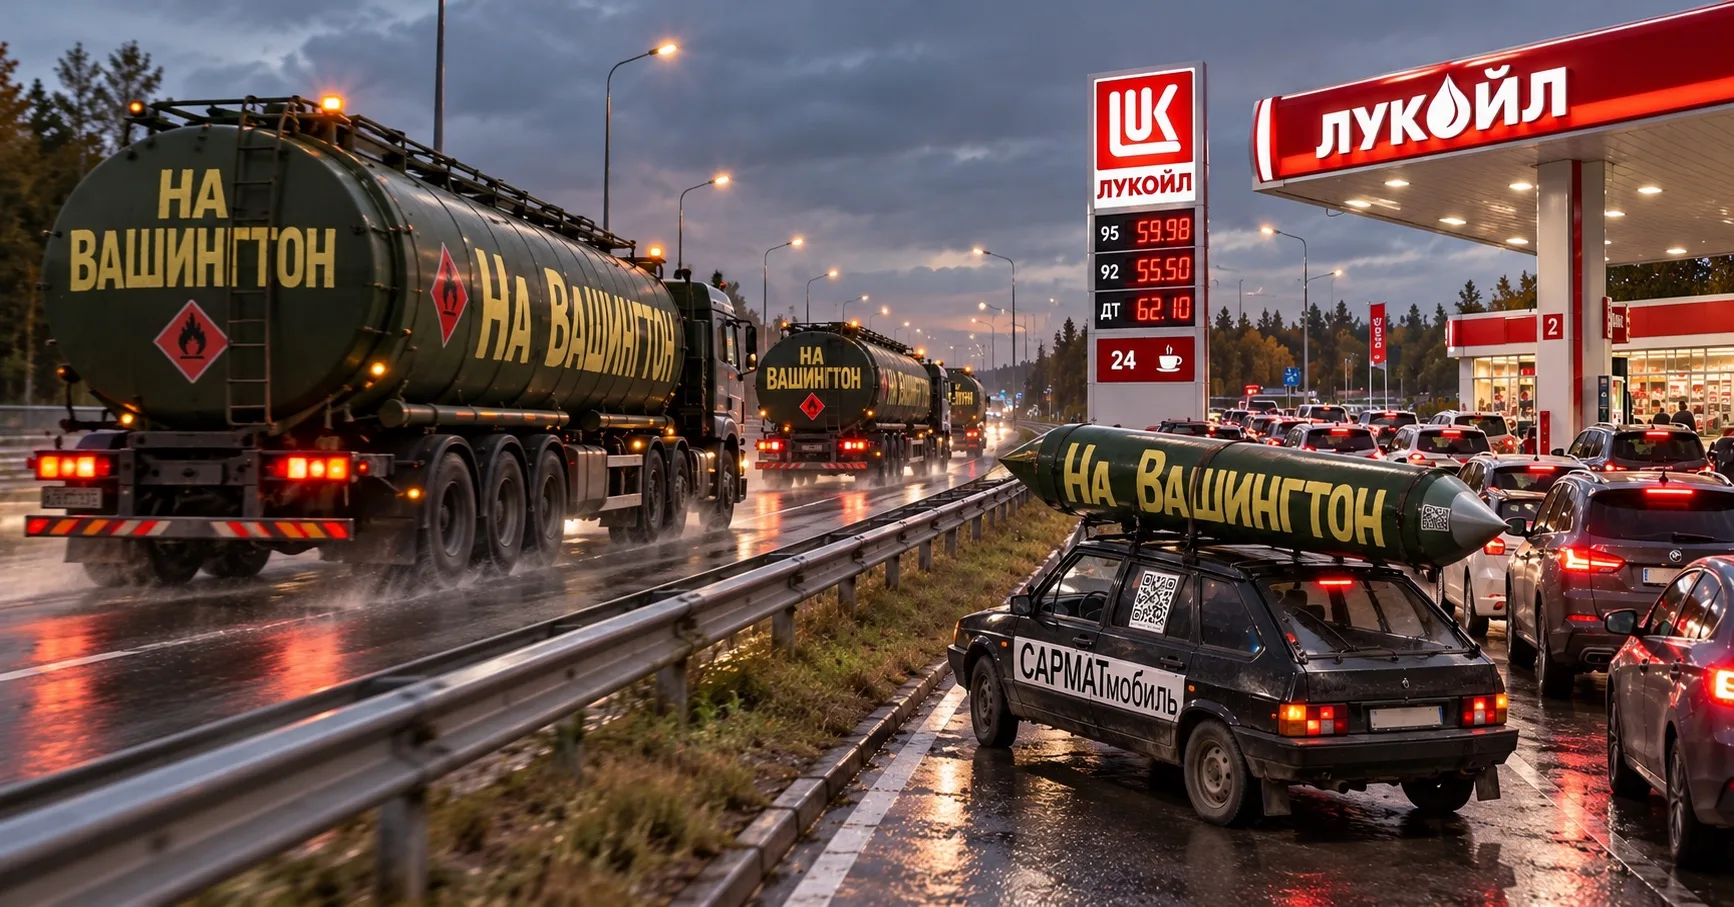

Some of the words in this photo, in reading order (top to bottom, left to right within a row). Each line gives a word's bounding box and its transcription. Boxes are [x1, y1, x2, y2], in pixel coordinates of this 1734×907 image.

[1315, 64, 1569, 160] ЛУКОЙЛ
[157, 168, 229, 220] НА
[1096, 169, 1192, 200] ЛУКОЙЛ
[1100, 225, 1120, 242] 95
[1137, 217, 1191, 244] 59.98
[70, 226, 336, 292] ВАШИНГТОН
[1100, 263, 1119, 280] 92
[1137, 256, 1191, 283] 55.50
[1100, 302, 1121, 321] ДТ
[1137, 295, 1191, 321] 62.10
[1548, 318, 1558, 336] 2
[800, 346, 825, 365] НА
[1111, 350, 1137, 370] 24
[766, 366, 862, 390] ВАШИНГТОН
[1020, 642, 1178, 716] САРМАТмобиль
